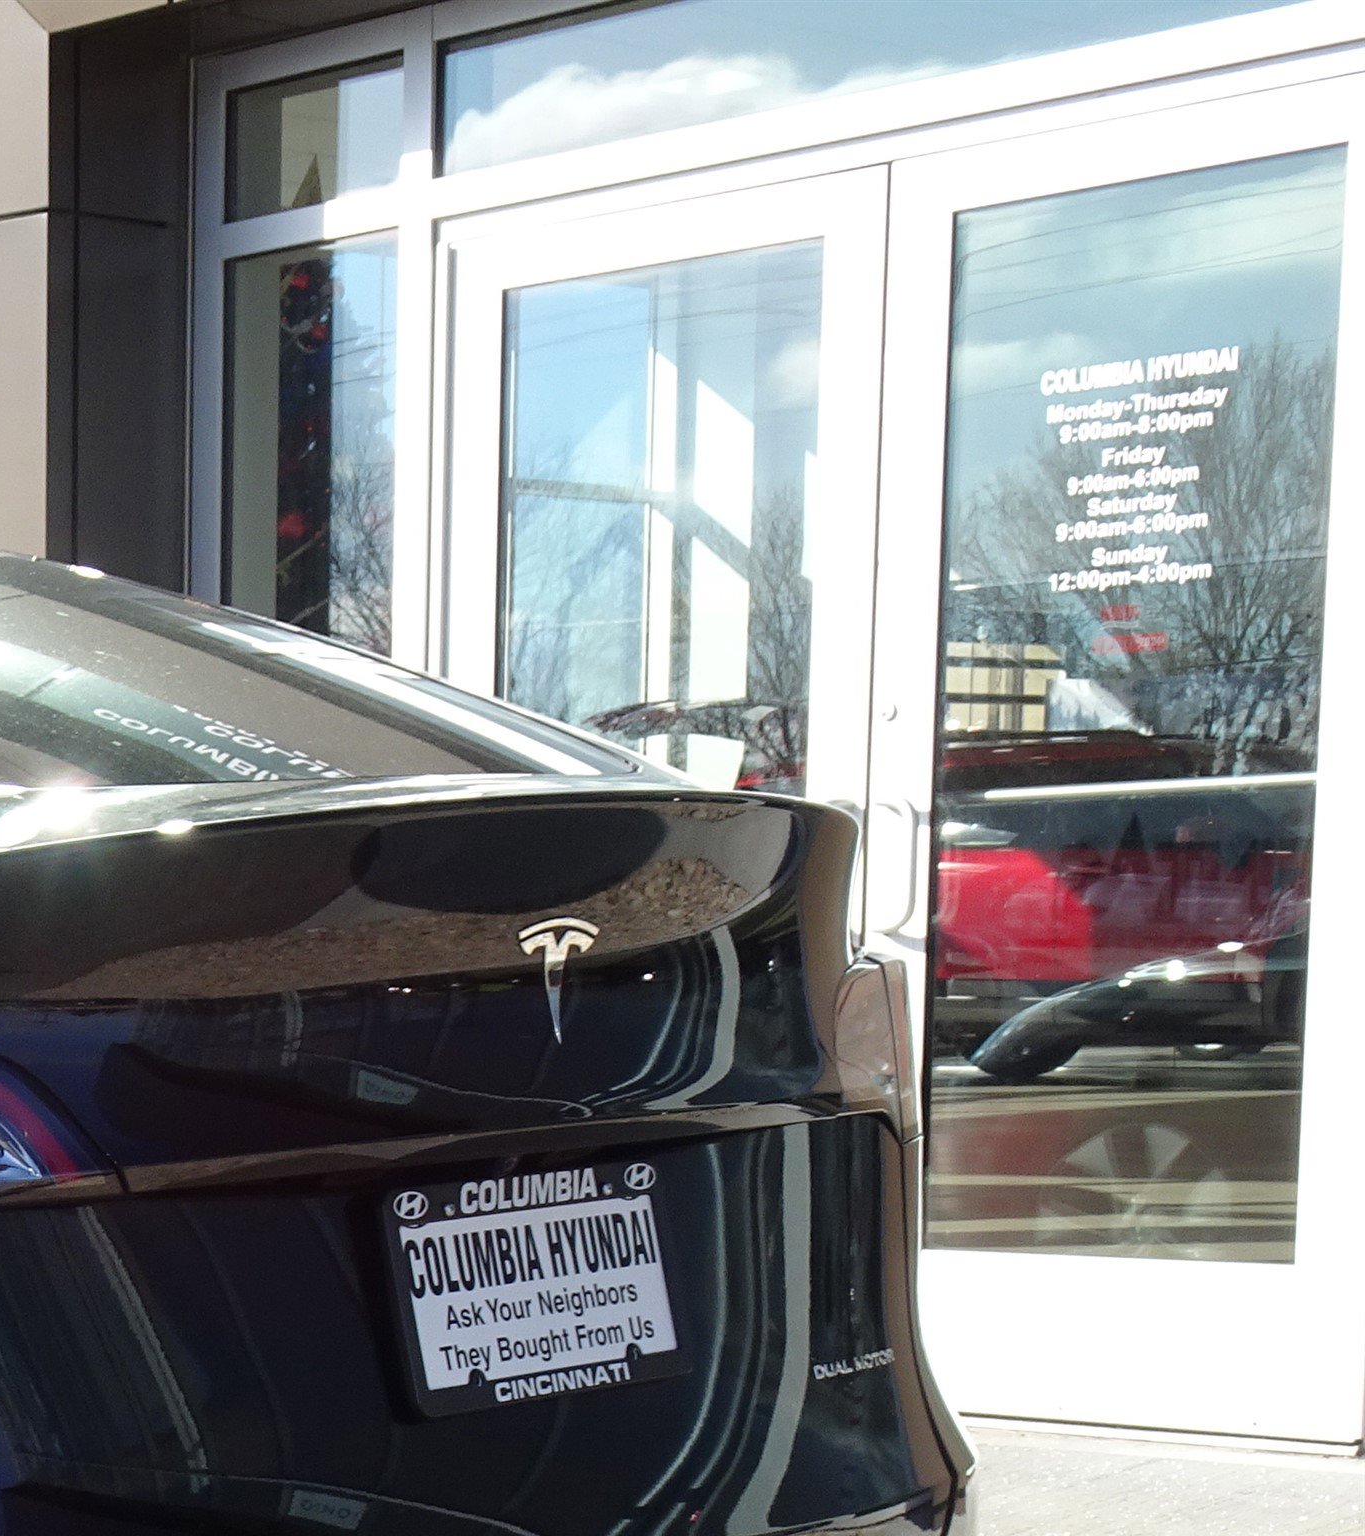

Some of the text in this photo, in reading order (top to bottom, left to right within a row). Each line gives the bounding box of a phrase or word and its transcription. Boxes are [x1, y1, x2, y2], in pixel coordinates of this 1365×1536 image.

[1040, 345, 1240, 397] COLUMBIA HYUNDAI
[1045, 385, 1229, 425] Monday-Thursday
[1058, 410, 1215, 445] 9:00am-8:00pm
[1100, 443, 1167, 468] Friday
[1066, 464, 1201, 497] 9:00am-6:00pm
[1086, 491, 1178, 517] Saturday
[1054, 511, 1210, 543] 9:00am-6:00pm
[1090, 543, 1169, 568] Sunday
[1047, 562, 1213, 593] 12:00pm-4:00pm
[459, 1167, 598, 1214] COLUMBIA
[403, 1208, 657, 1299] COLUMBIA HYUNDAI
[446, 1283, 639, 1331] Ask Your Neighbors
[439, 1315, 655, 1372] They Bought From Us
[494, 1362, 631, 1403] CINCINNATI
[813, 1359, 854, 1380] DUAL
